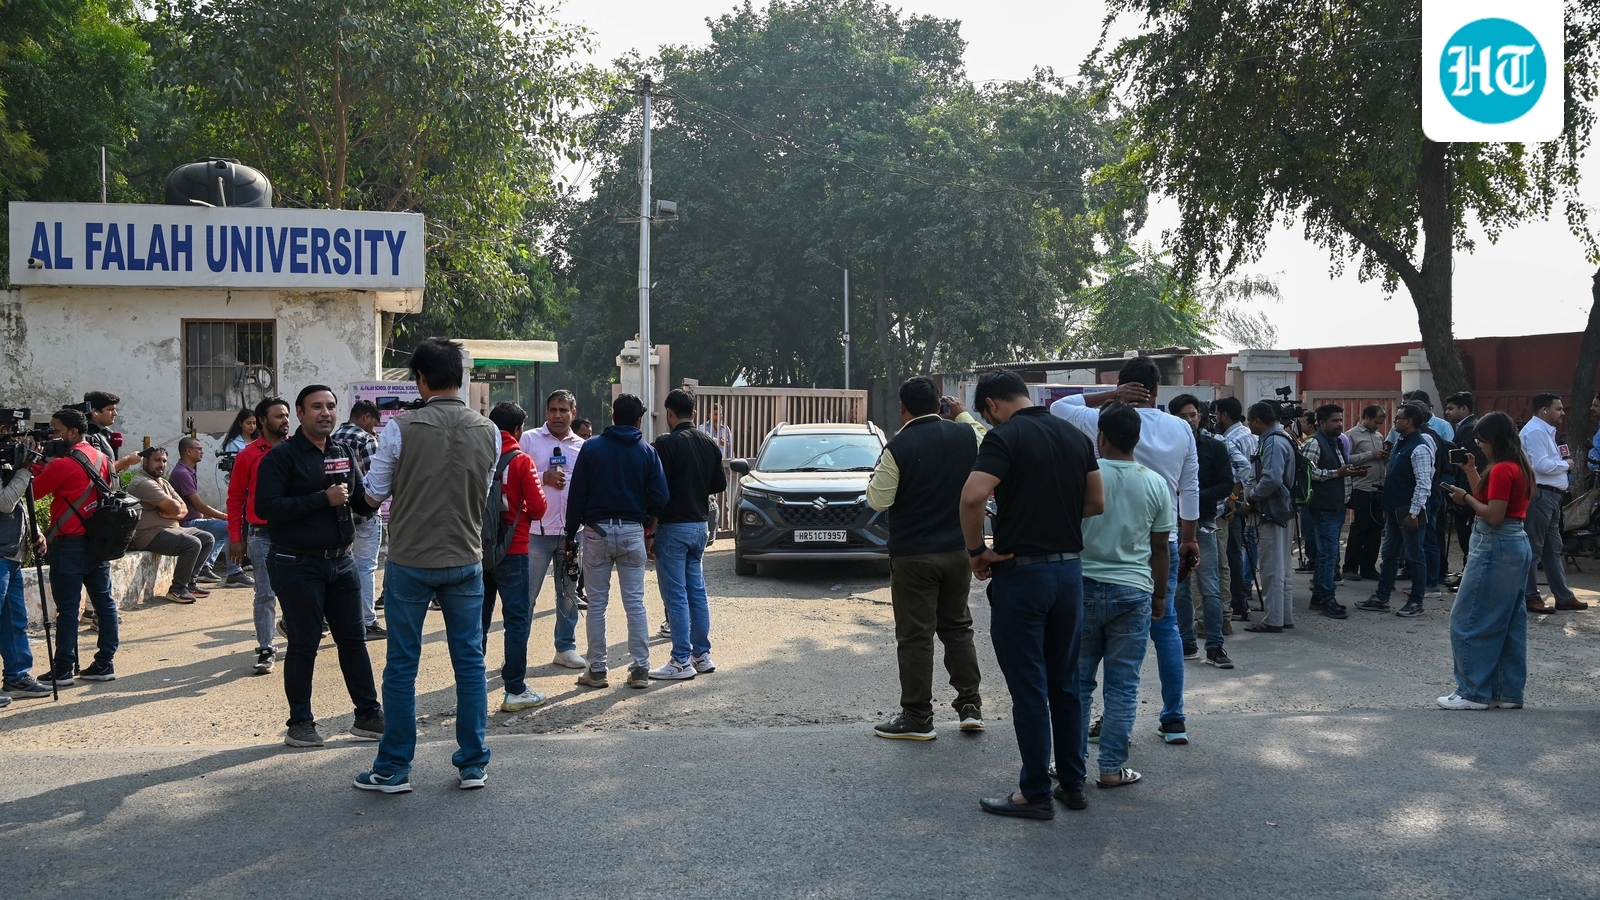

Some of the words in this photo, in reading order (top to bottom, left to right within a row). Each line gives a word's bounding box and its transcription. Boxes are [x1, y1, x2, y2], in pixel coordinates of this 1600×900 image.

[28, 221, 73, 269] AL
[85, 222, 193, 272] FALAH
[206, 225, 407, 276] UNIVERSITY
[799, 531, 846, 540] HR51CT9957
